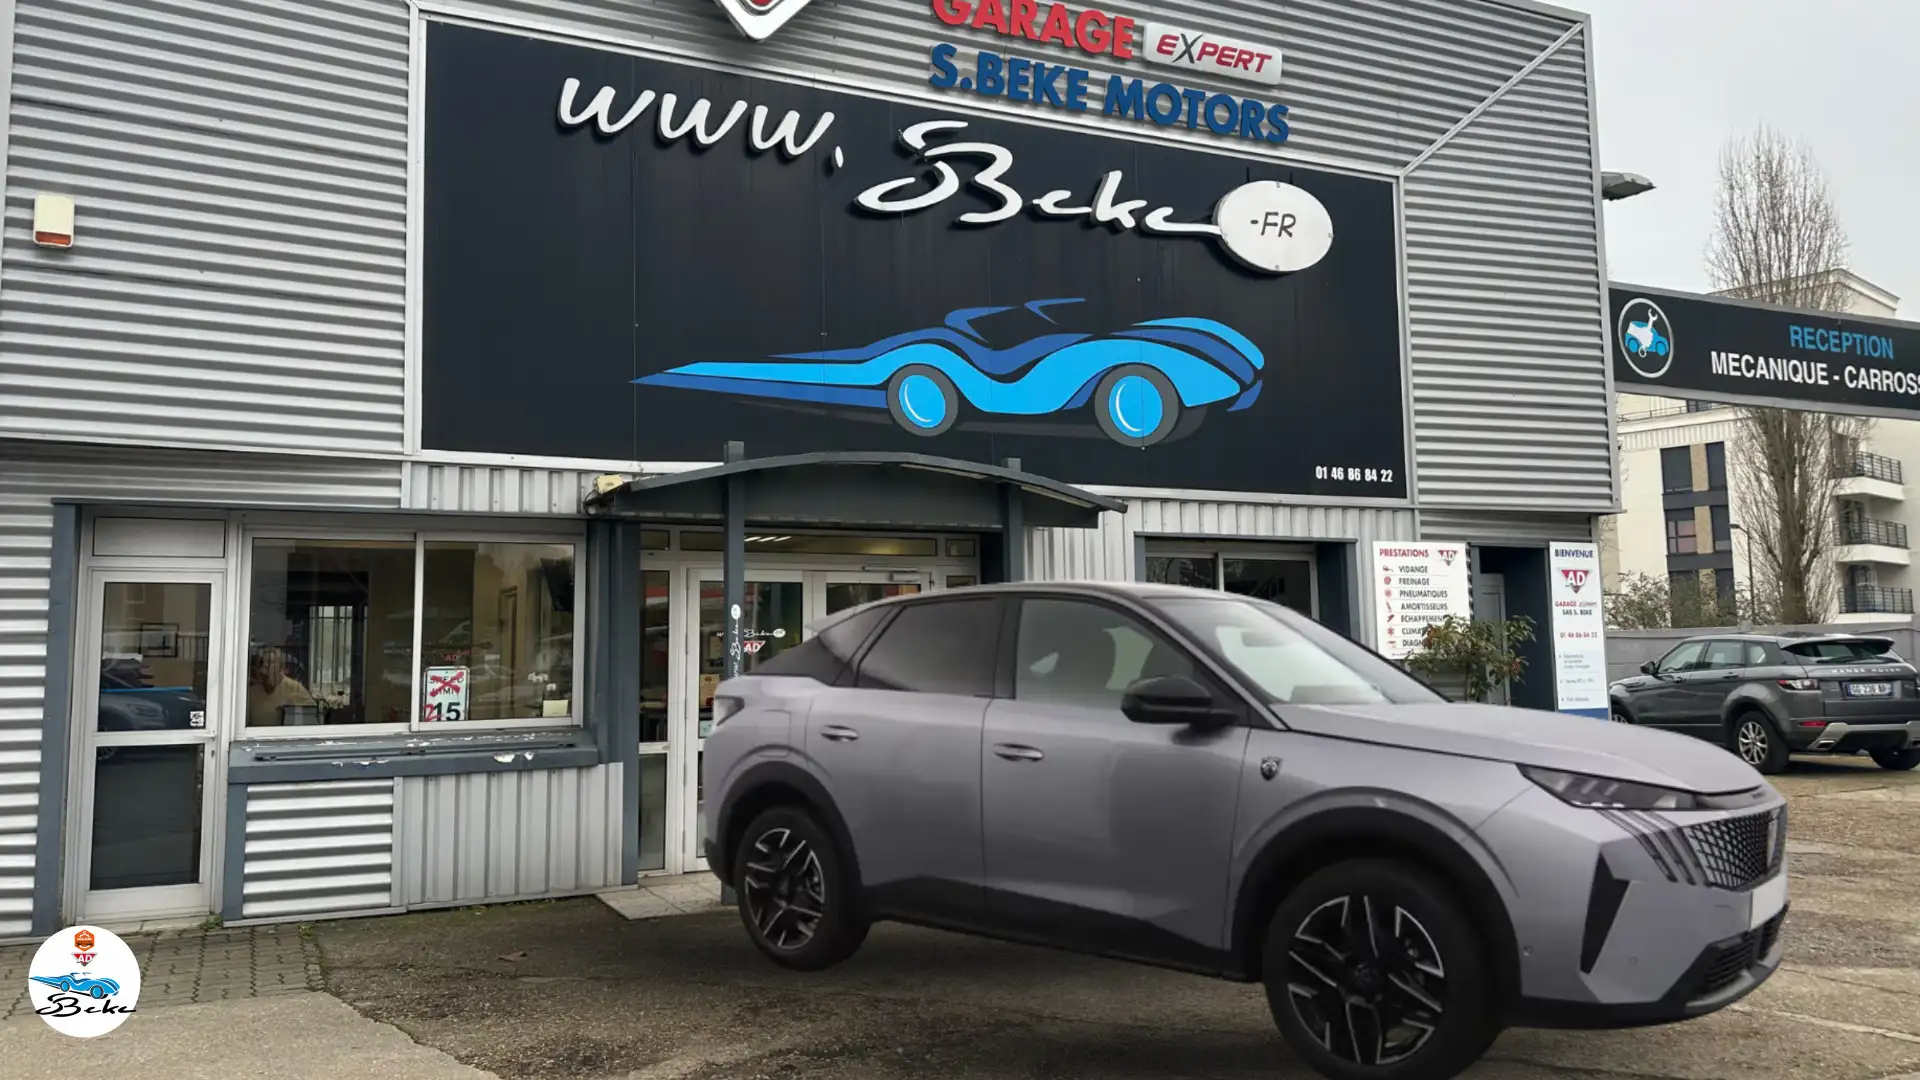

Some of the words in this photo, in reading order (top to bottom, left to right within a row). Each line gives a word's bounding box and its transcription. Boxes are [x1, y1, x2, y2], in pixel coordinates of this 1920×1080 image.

[933, 0, 1134, 58] GARAGE
[929, 43, 1089, 112] S.BEKE
[1104, 75, 1289, 143] MOTORS
[1789, 325, 1895, 359] RECEPTION
[1711, 351, 1829, 386] MECANIQUE
[1844, 365, 1920, 396] CARROS
[1315, 465, 1328, 480] 01
[1331, 466, 1345, 481] 46
[1347, 467, 1361, 481] 86
[1364, 468, 1378, 482] 84
[1380, 469, 1393, 483] 22
[1379, 548, 1429, 558] PRESTATIONS
[1554, 548, 1594, 558] BIENVENUE
[1398, 565, 1429, 574] VIDANGE
[1398, 577, 1430, 586] FREINAGE
[1567, 571, 1587, 587] AD
[1400, 590, 1449, 599] PNEUMATIQUES
[1400, 603, 1448, 611] AMORTISSEURS
[1400, 614, 1444, 623] ECHAPPEMEN
[1401, 627, 1422, 635] CLIMA
